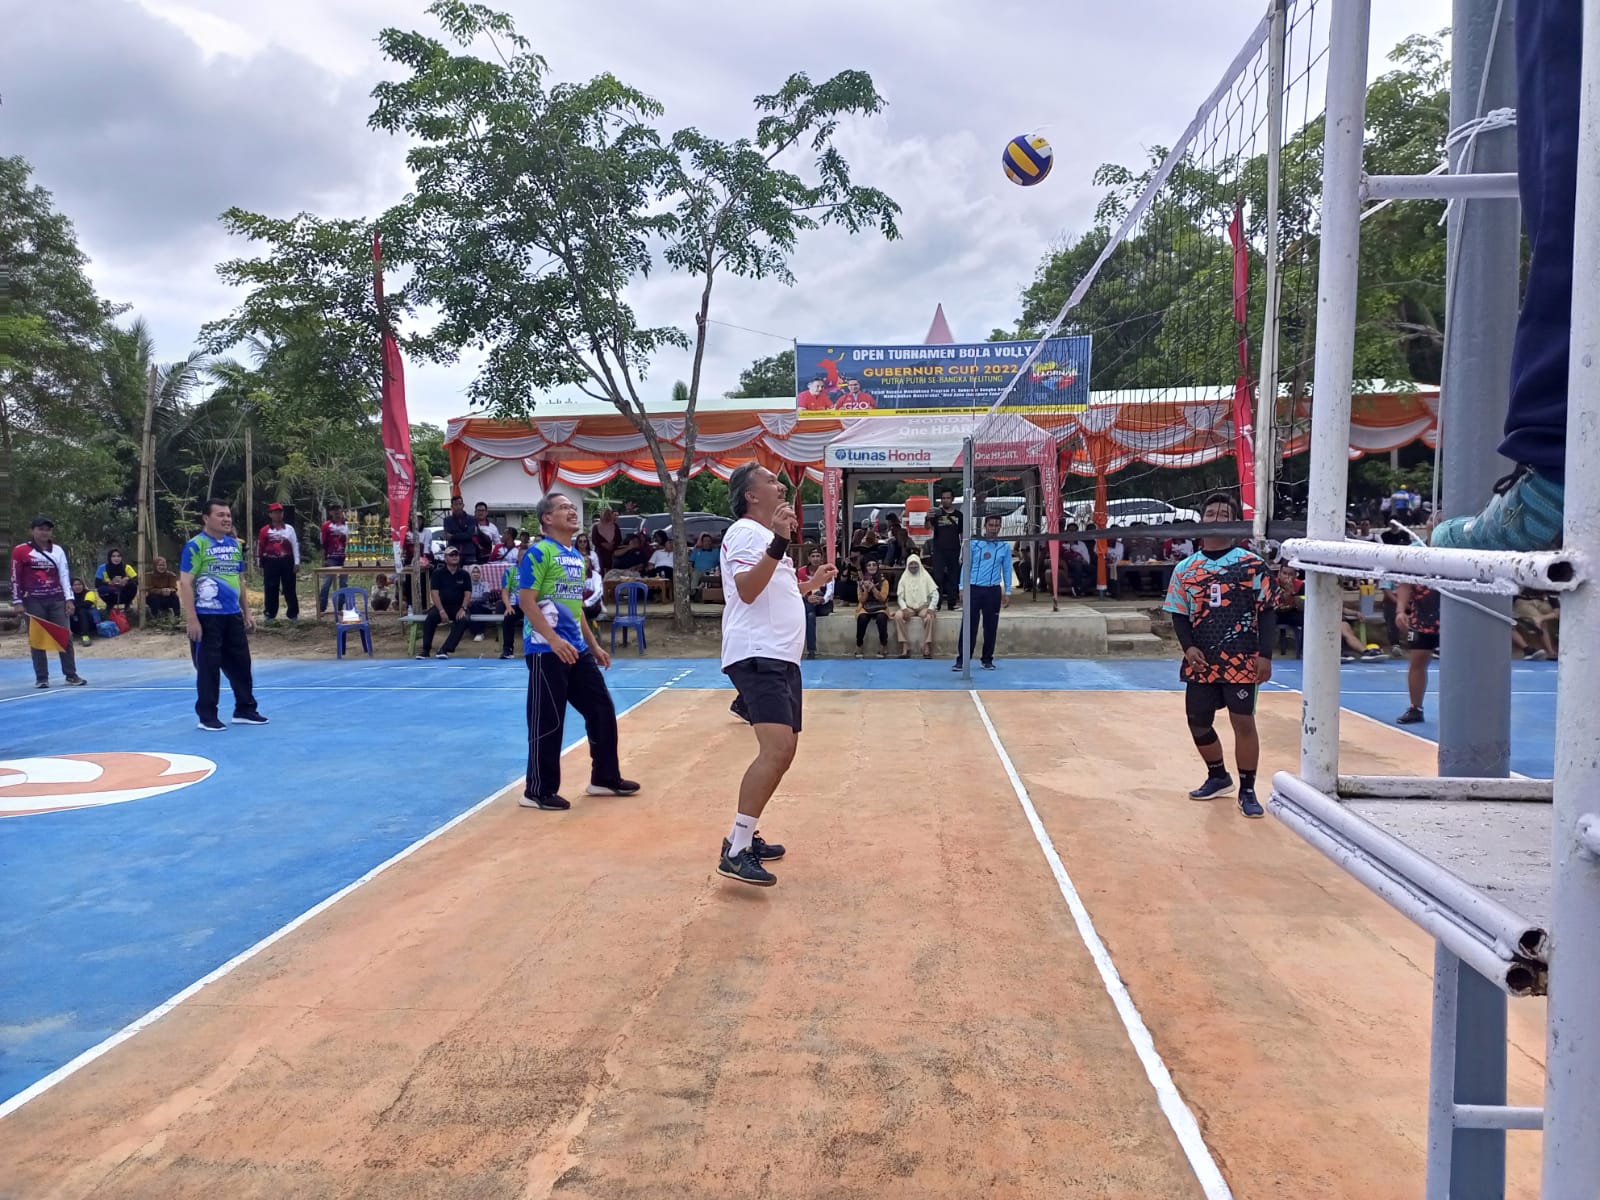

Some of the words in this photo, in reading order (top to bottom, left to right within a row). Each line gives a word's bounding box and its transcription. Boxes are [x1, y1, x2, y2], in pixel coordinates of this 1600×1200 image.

[852, 349, 884, 361] OPEN
[887, 348, 955, 360] TURNAMEN
[959, 347, 991, 358] BOLA
[994, 346, 1033, 358] VOLLY
[863, 366, 944, 377] GUBERNUR
[947, 364, 979, 375] CUP
[983, 364, 1018, 374] 2022
[881, 376, 904, 385] PUTRA
[905, 376, 926, 384] PUTRI
[927, 375, 968, 384] SE-BANGKA
[969, 375, 1003, 383] BELITUNG
[844, 401, 869, 409] G20
[899, 426, 929, 436] One
[847, 449, 887, 461] tunas
[888, 449, 931, 461] Honda
[974, 451, 991, 460] One
[1208, 583, 1221, 608] 9
